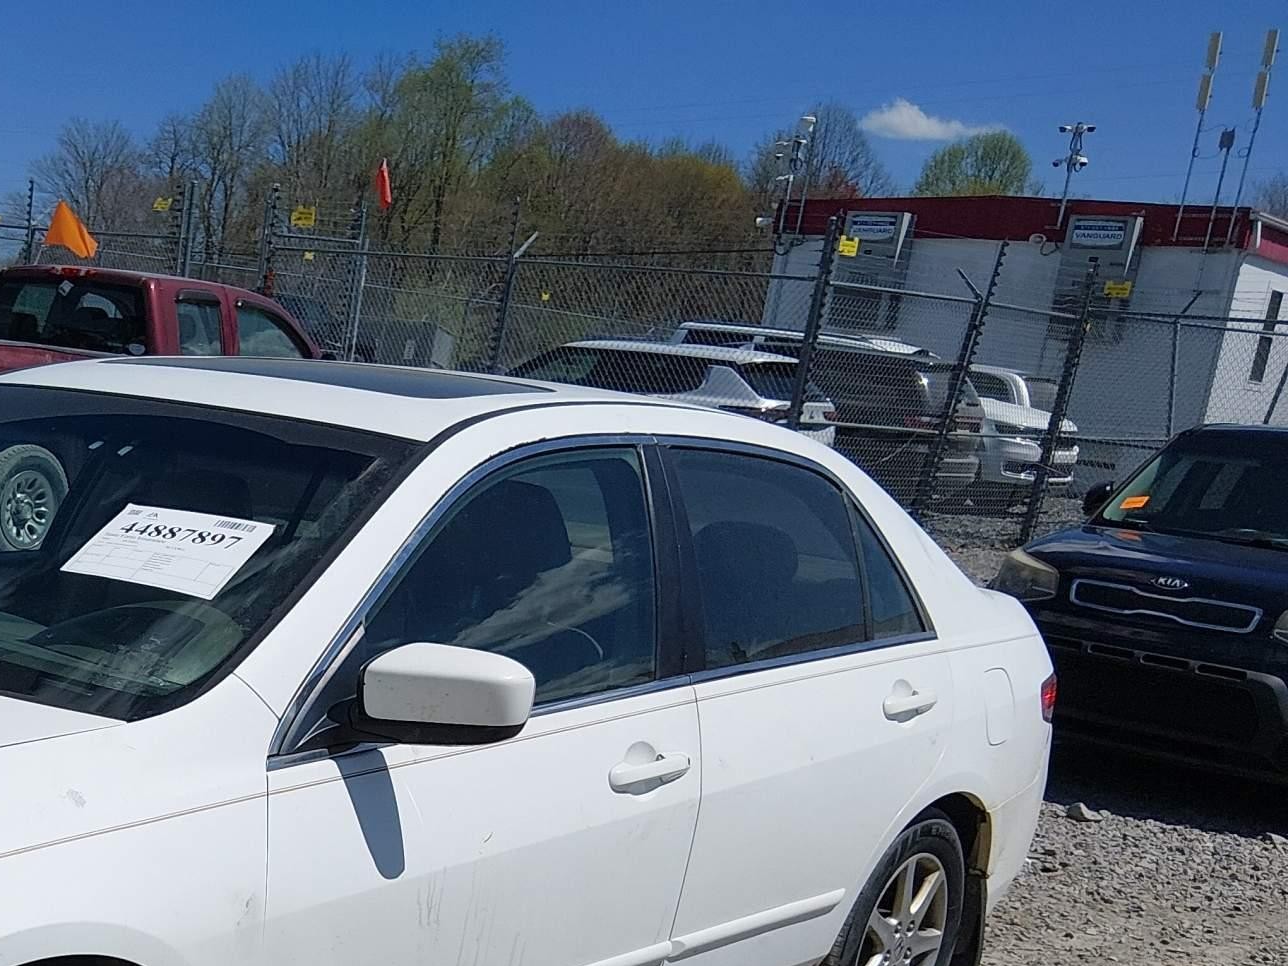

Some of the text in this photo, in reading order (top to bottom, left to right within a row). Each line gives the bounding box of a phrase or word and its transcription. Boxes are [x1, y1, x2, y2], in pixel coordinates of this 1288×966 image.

[1075, 232, 1122, 240] VANGUARD
[120, 521, 243, 550] 44887897
[1157, 577, 1181, 588] KIA
